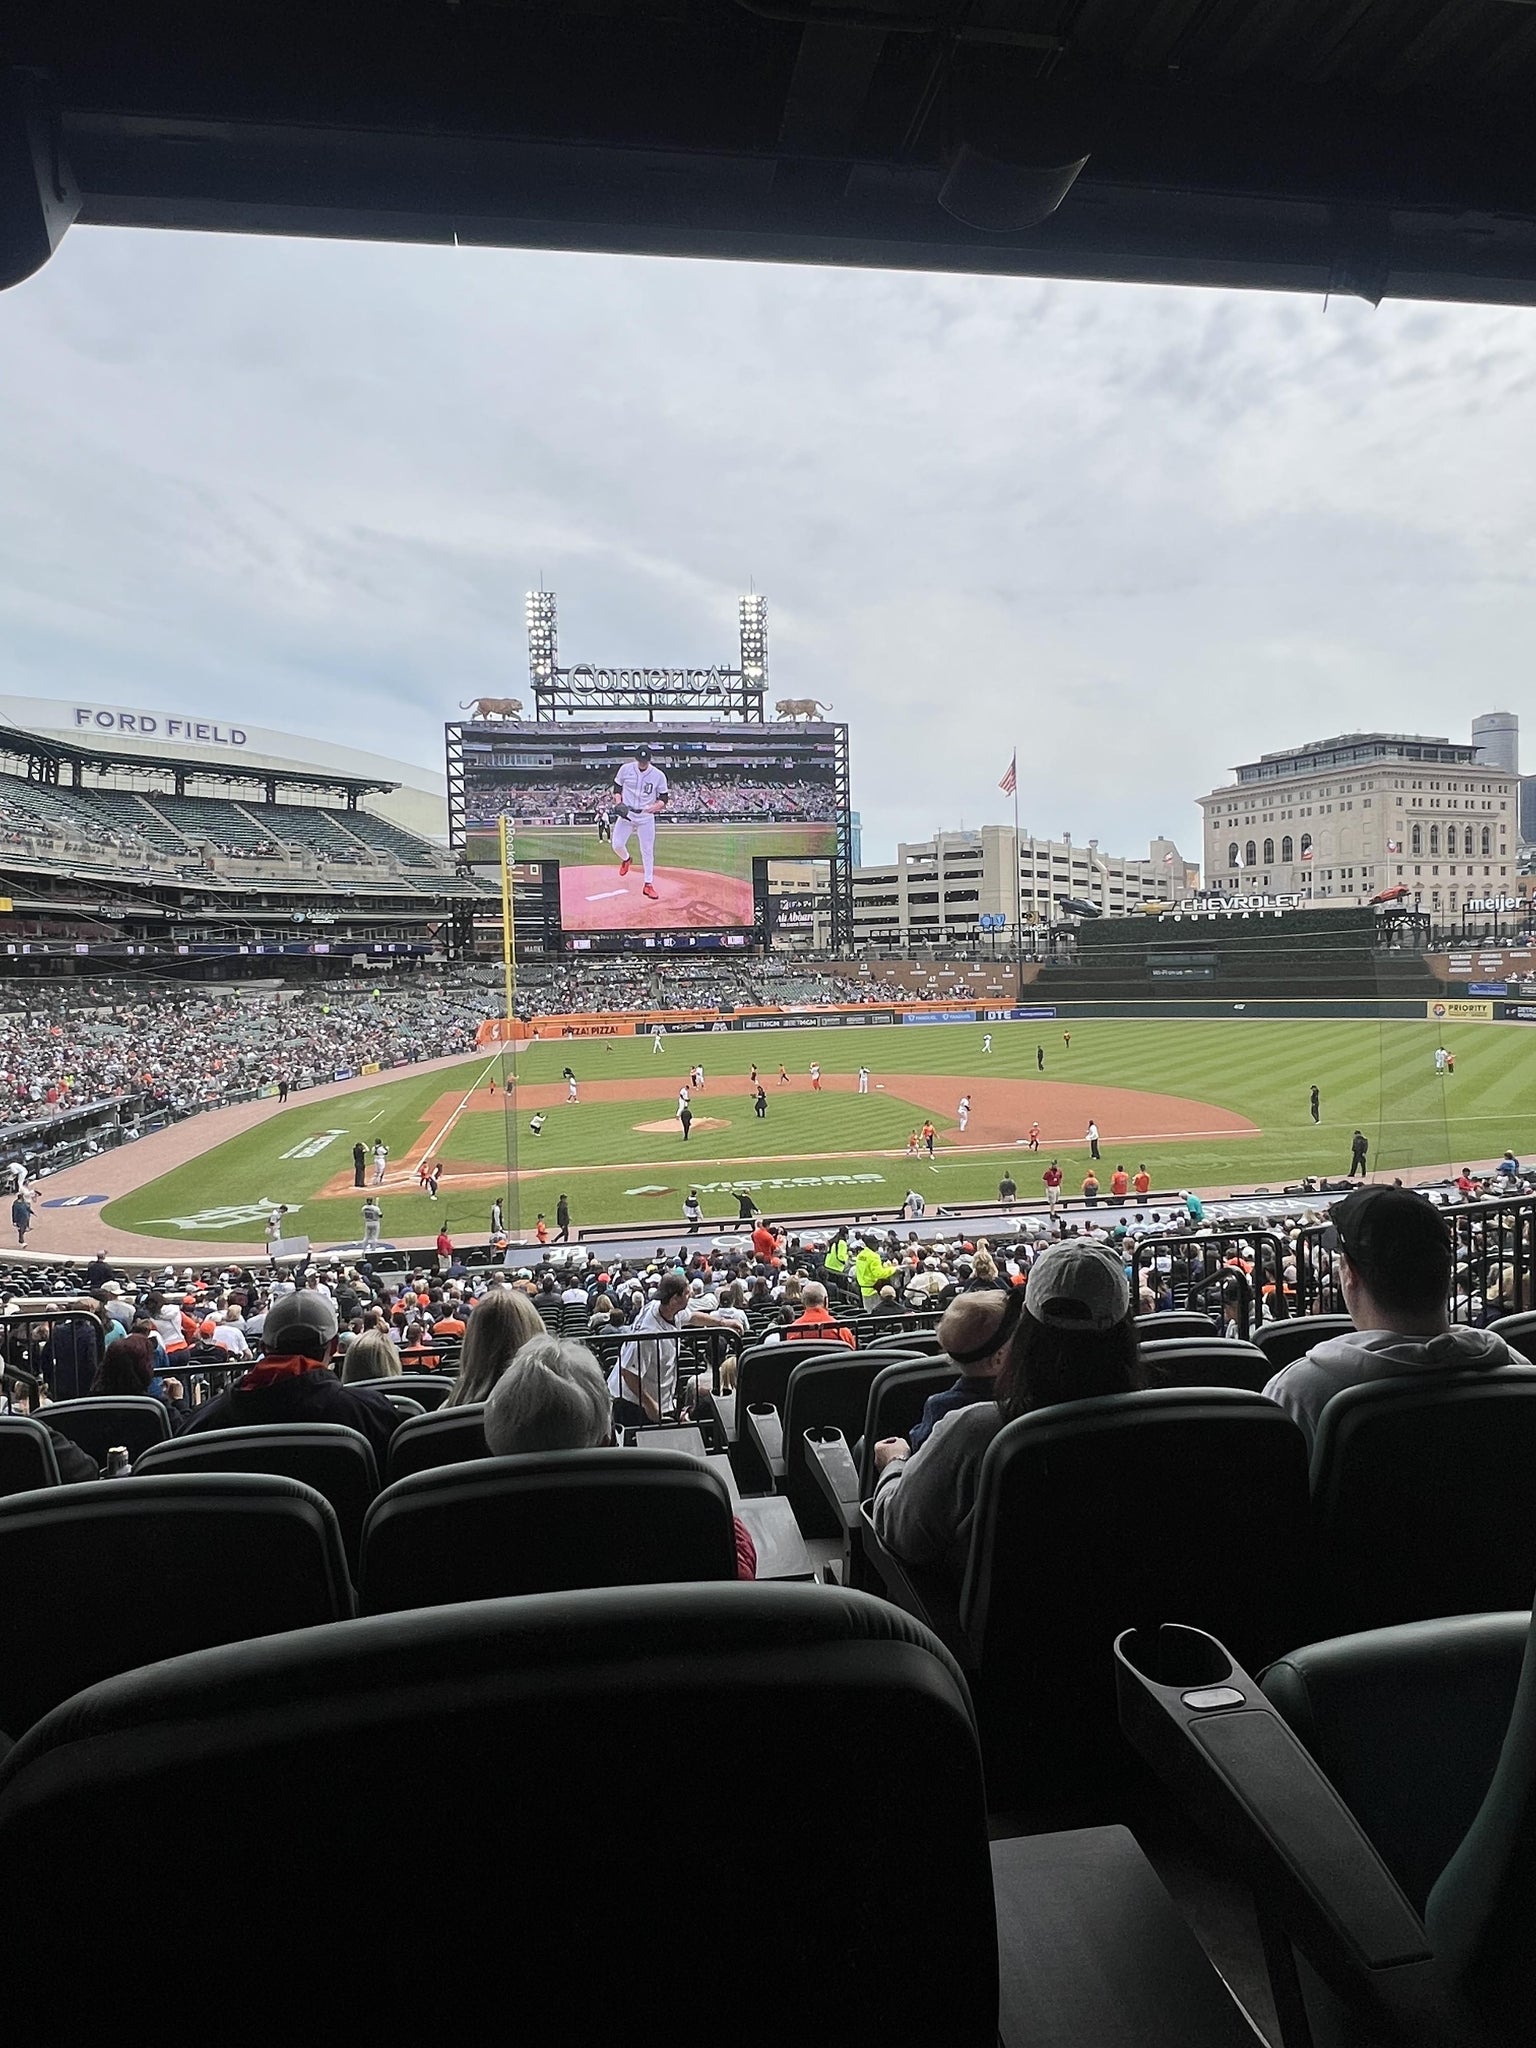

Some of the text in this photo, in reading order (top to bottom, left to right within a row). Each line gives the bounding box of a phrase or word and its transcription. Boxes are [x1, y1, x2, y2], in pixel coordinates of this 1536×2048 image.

[613, 693, 688, 706] PARK
[75, 708, 247, 746] FORD FIELD
[1180, 893, 1303, 912] CHEVROLET
[1468, 894, 1525, 912] meijer
[1157, 910, 1284, 923] FOUNTAIN
[988, 1010, 1012, 1020] DTE
[591, 1022, 619, 1034] PIZZA!
